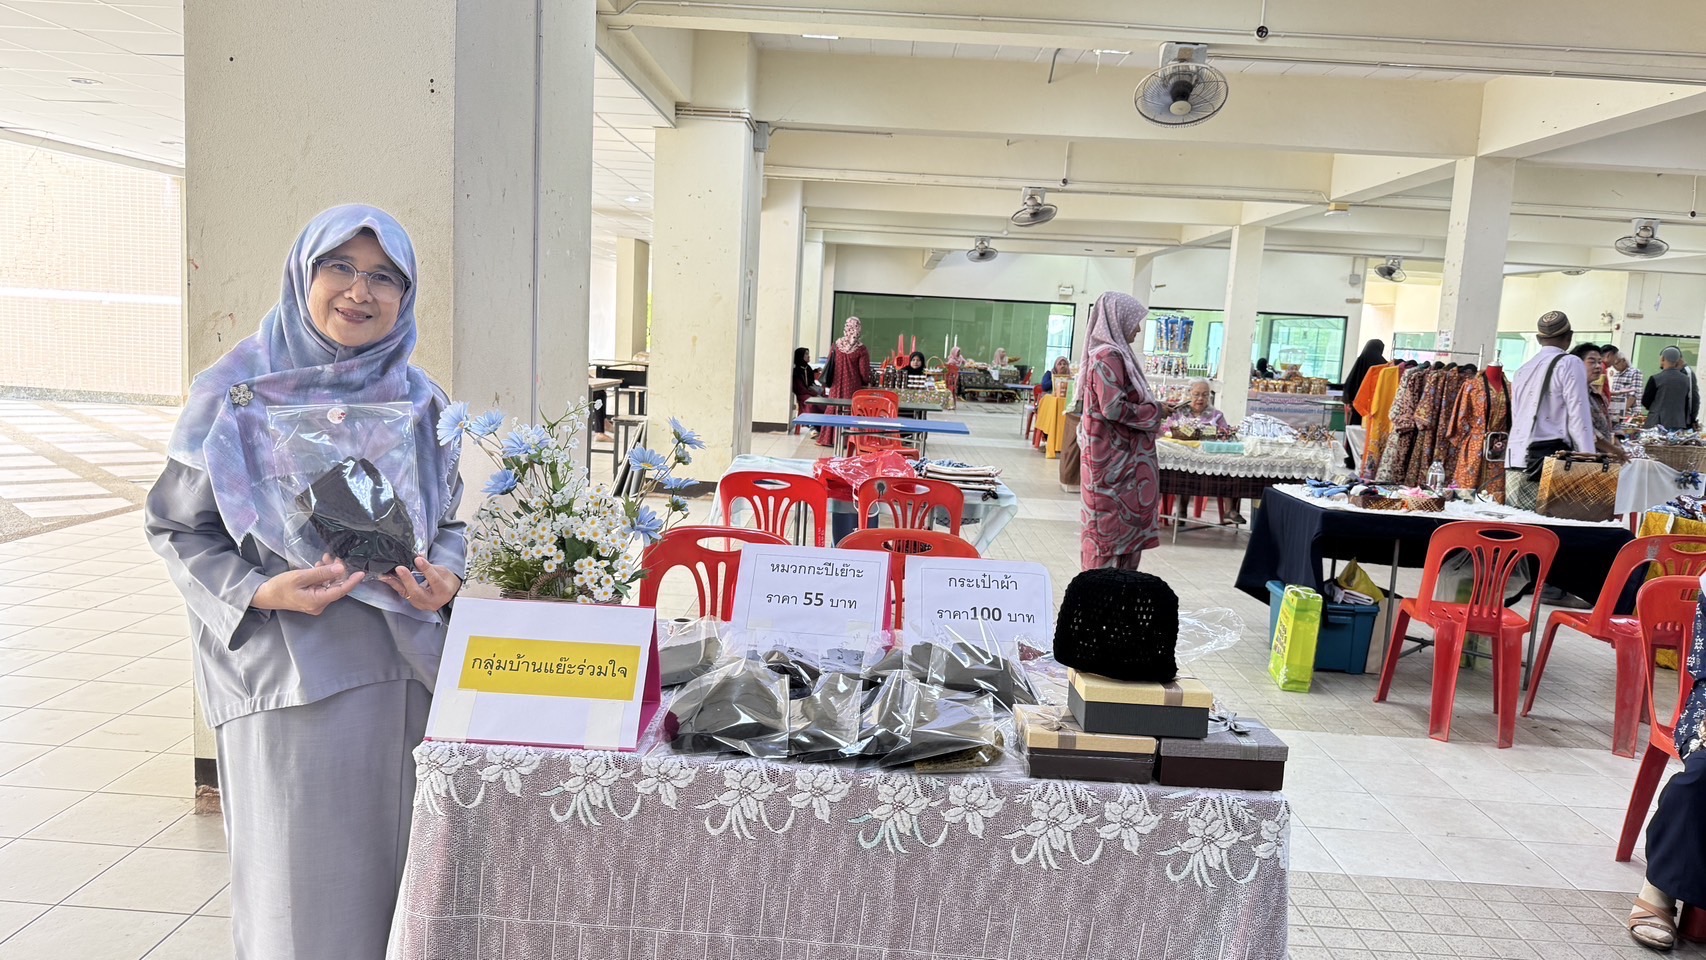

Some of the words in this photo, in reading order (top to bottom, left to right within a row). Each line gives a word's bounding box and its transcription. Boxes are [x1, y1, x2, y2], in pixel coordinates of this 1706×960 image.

[948, 573, 1018, 590] กระเป๋าผ้า
[766, 593, 798, 604] ราคา
[803, 592, 824, 606] 55
[829, 598, 857, 609] บาท
[1007, 612, 1035, 623] บาท
[471, 653, 628, 678] กลุ่มบ้านแย๊ะร่วมใจ
